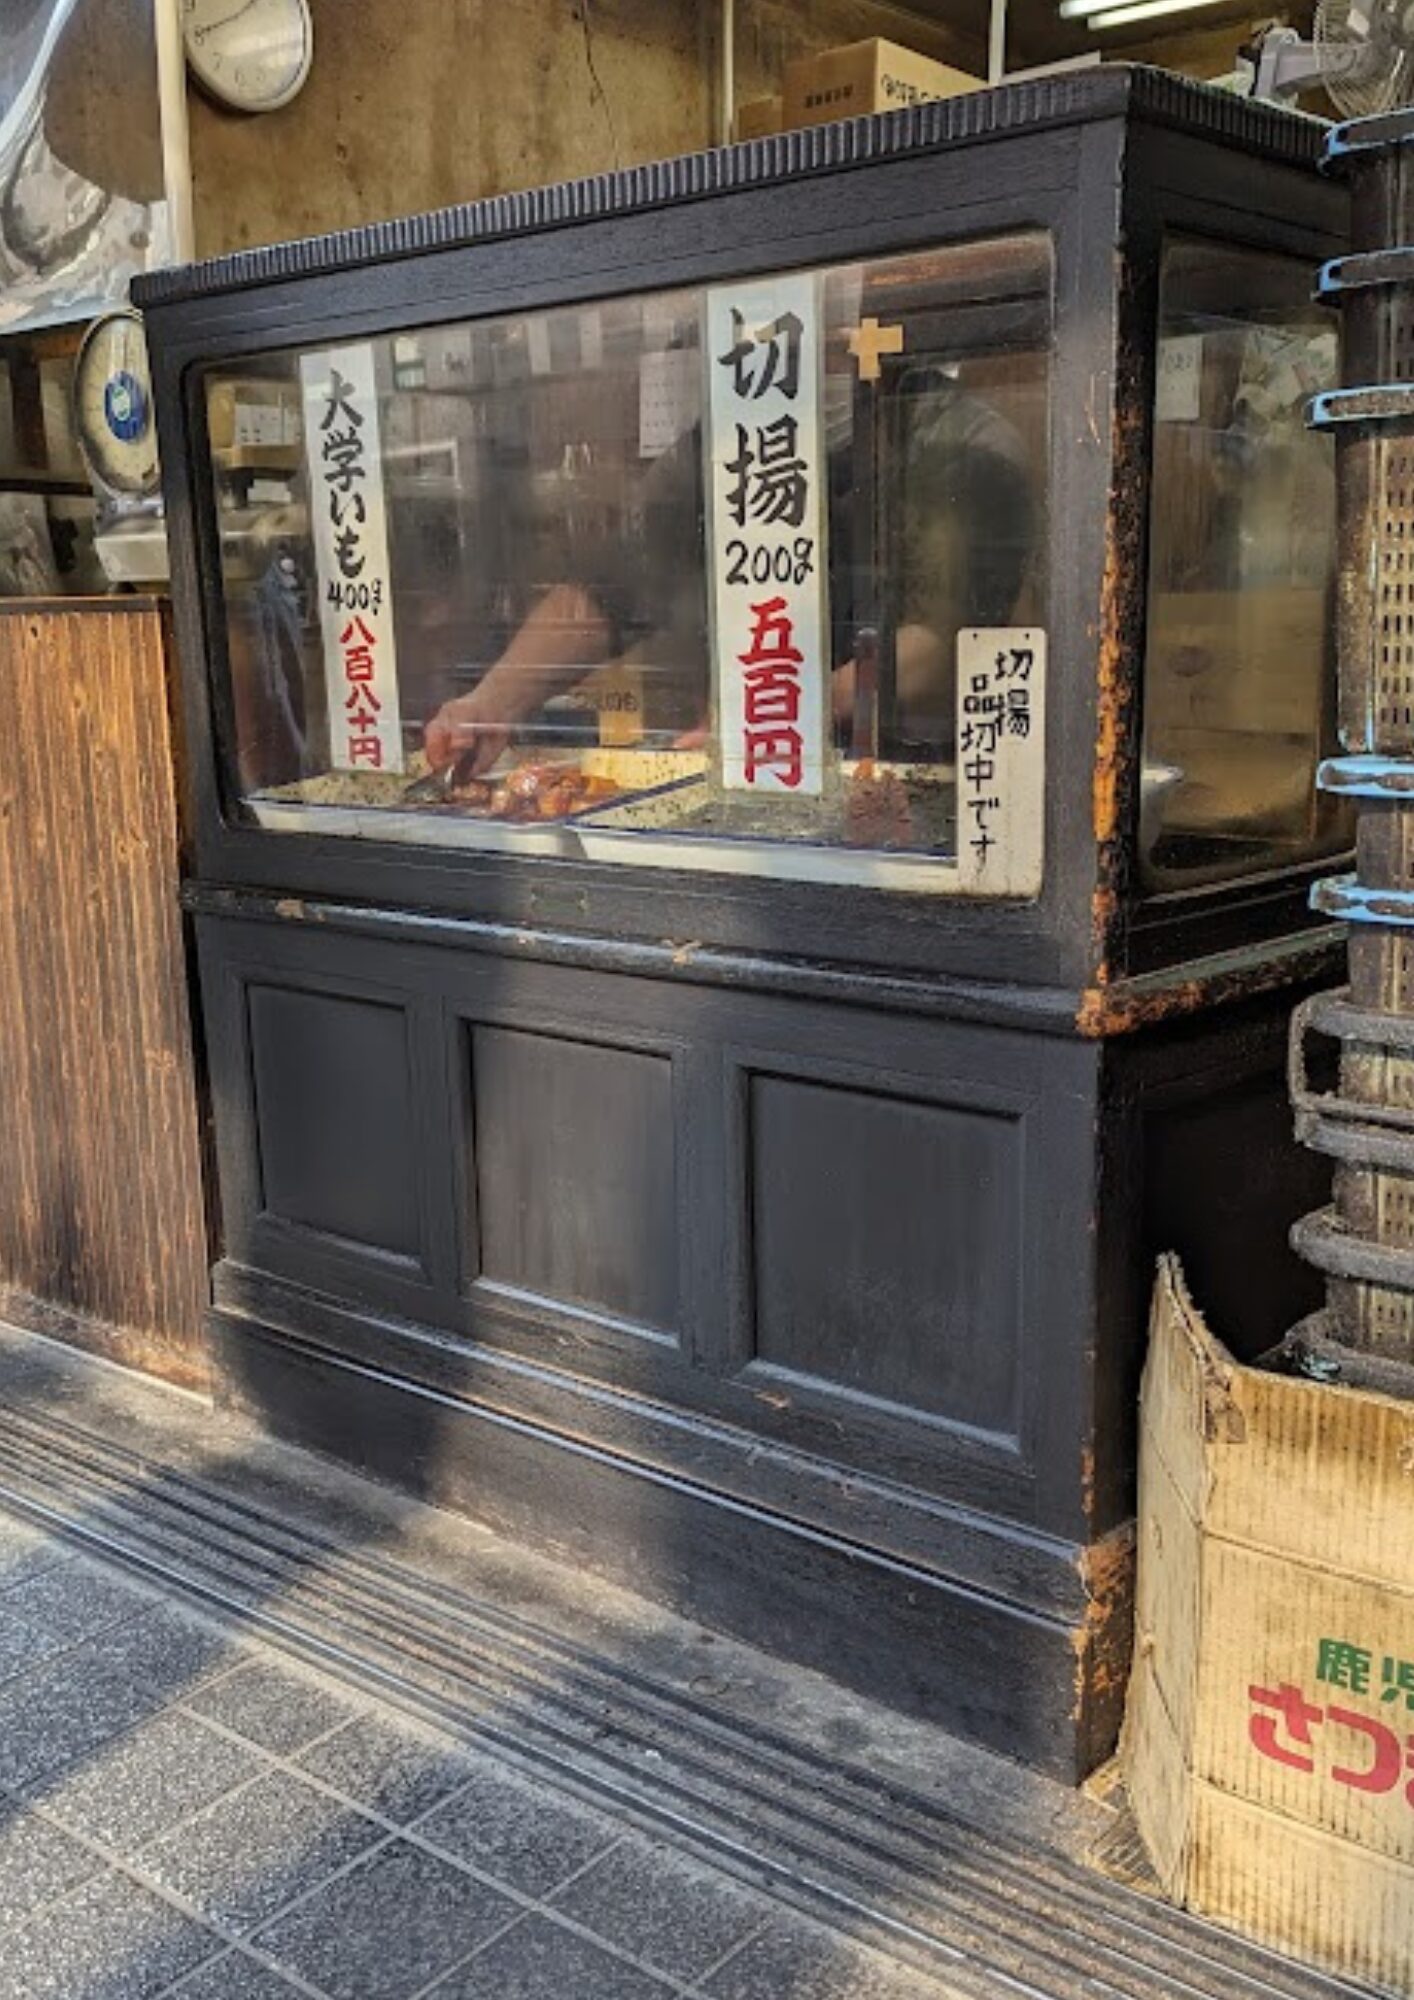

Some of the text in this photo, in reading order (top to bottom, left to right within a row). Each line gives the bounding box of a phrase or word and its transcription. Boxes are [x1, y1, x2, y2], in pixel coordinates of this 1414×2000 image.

[319, 368, 366, 579] 大学いも
[717, 307, 808, 528] 切揚
[339, 615, 382, 768] 八百八十円
[737, 596, 804, 788] 五百円
[961, 673, 1000, 873] 品切中です
[993, 649, 1033, 738] 切揚
[1248, 1682, 1414, 1810] さつ
